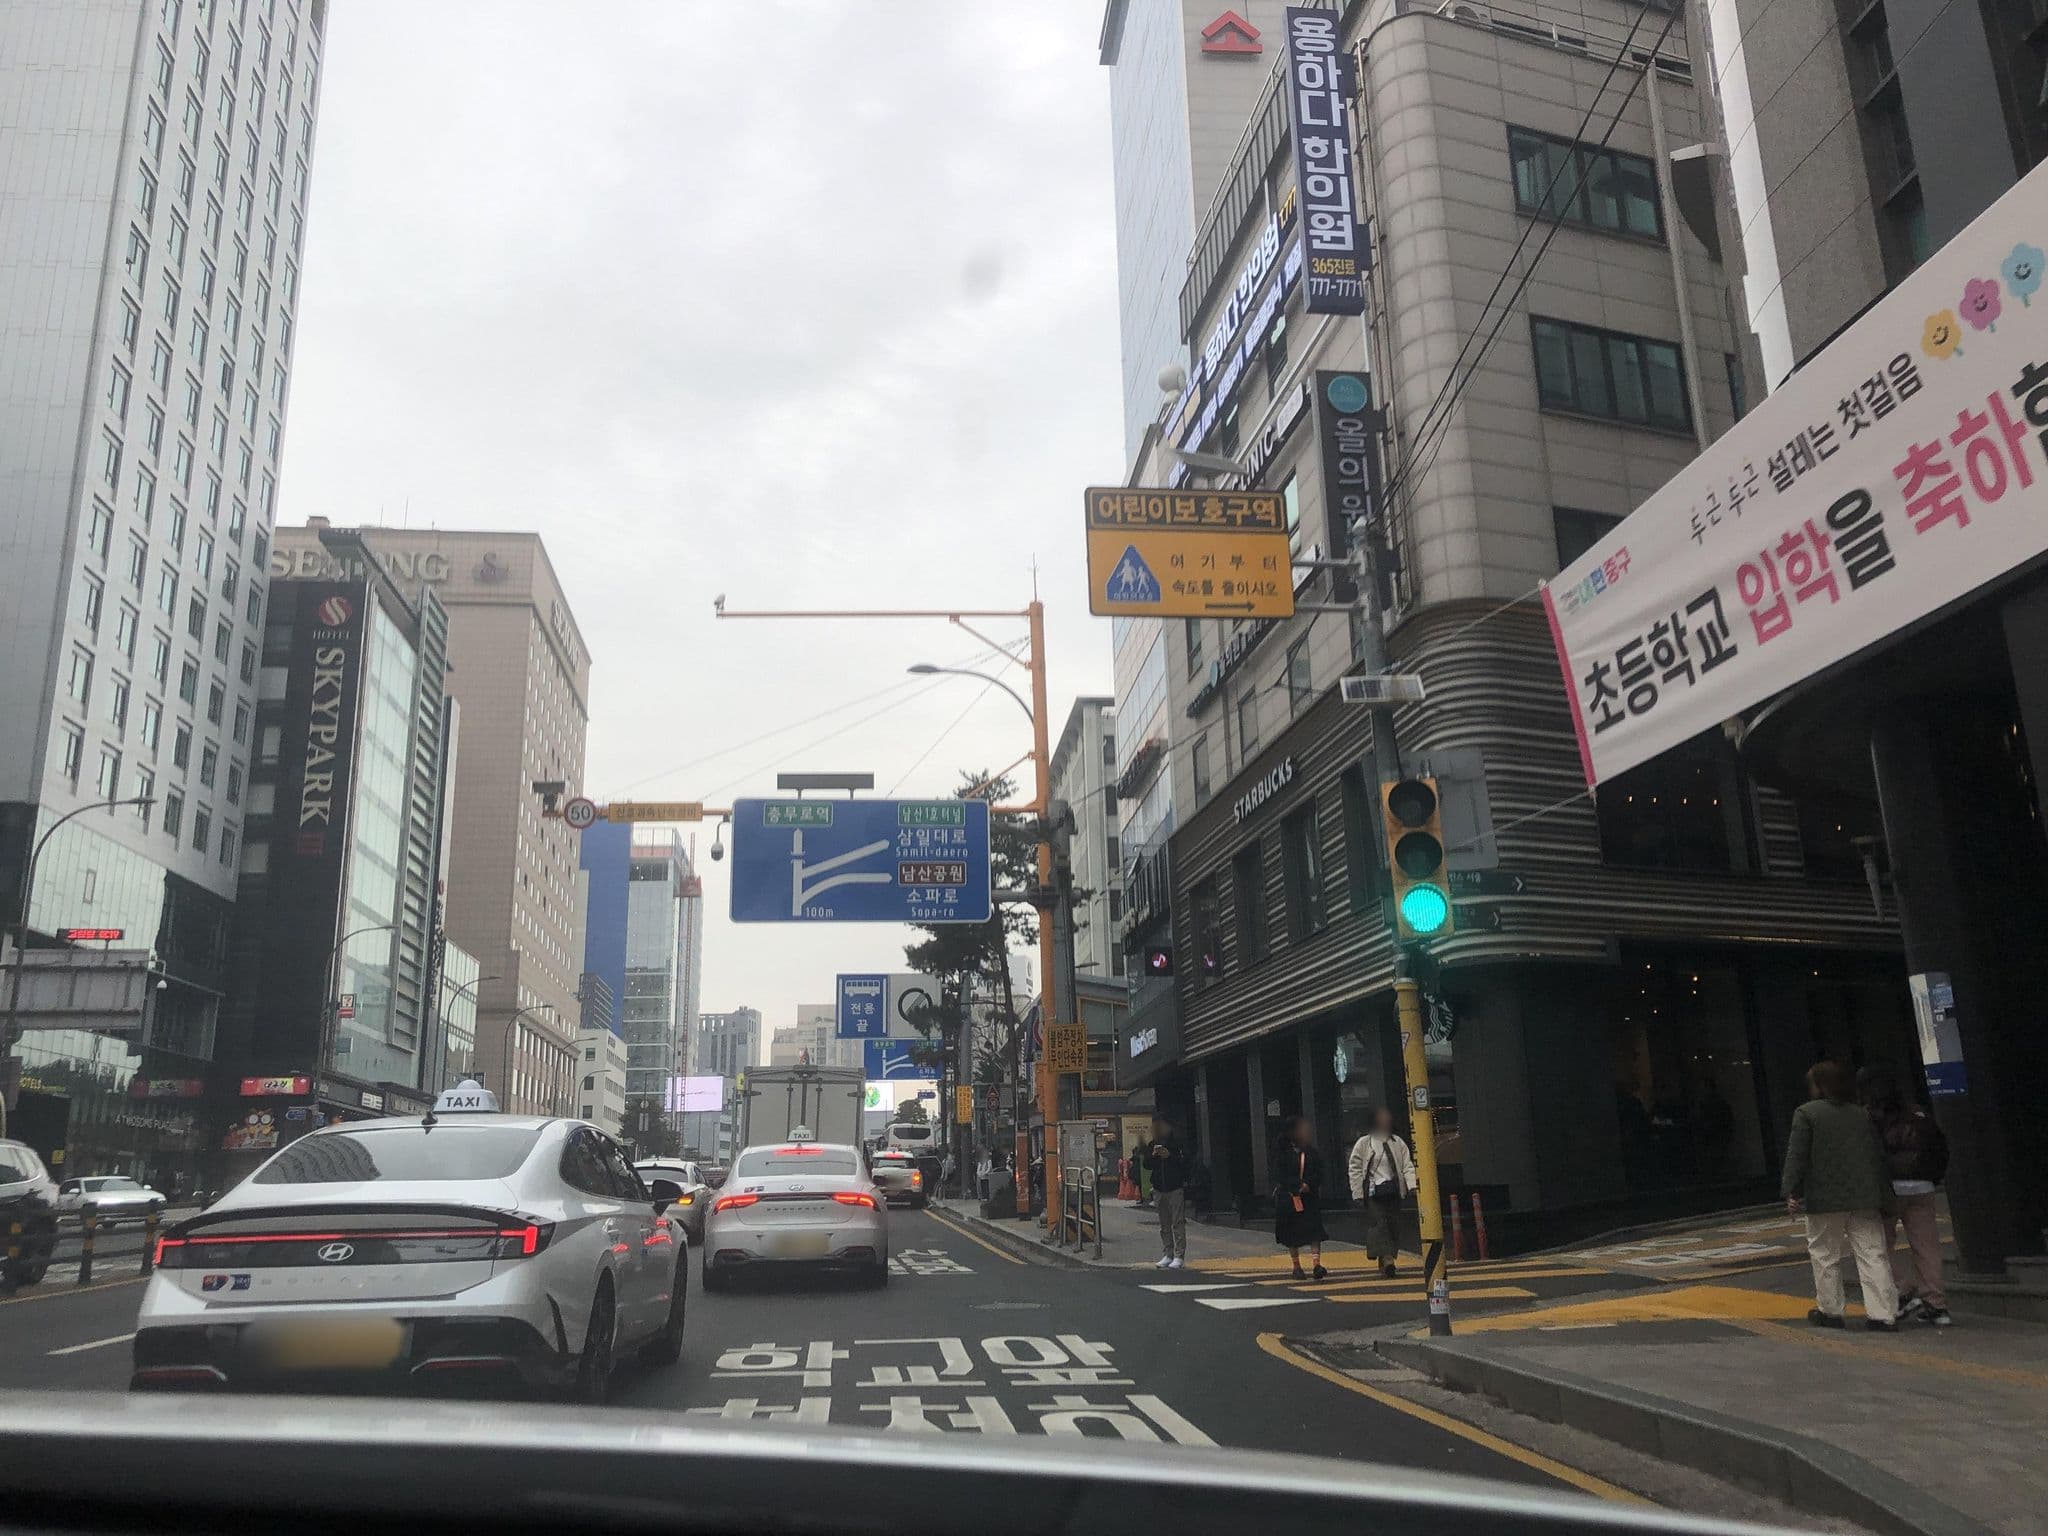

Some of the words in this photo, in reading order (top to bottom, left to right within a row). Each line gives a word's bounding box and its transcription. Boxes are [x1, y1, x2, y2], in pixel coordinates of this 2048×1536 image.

[1292, 16, 1345, 127] 용하다
[1302, 135, 1354, 251] 한의원
[1311, 257, 1356, 276] 365진료
[1767, 422, 1841, 495] 설레는
[1837, 352, 1924, 440] 첫걸음
[1099, 495, 1277, 526] 어린이보호구역
[271, 549, 449, 582] SENG
[1584, 585, 1739, 735] 초등학교
[1736, 488, 1897, 647] 입학을
[300, 647, 346, 827] SKYPARK
[1233, 756, 1293, 825] STARBUCKS
[570, 805, 591, 821] 50
[767, 806, 830, 823] 충무로역
[902, 806, 962, 824] 남산1호터널
[897, 828, 967, 847] 삼일대로
[896, 846, 969, 858] Samil-daero
[902, 865, 963, 883] 남산공원
[907, 888, 959, 904] 소파로
[805, 907, 834, 918] 100m
[911, 906, 955, 919] Sopa-ro
[850, 1002, 876, 1016] 전용
[856, 1019, 869, 1033] 끝
[445, 1096, 481, 1108] TAXI
